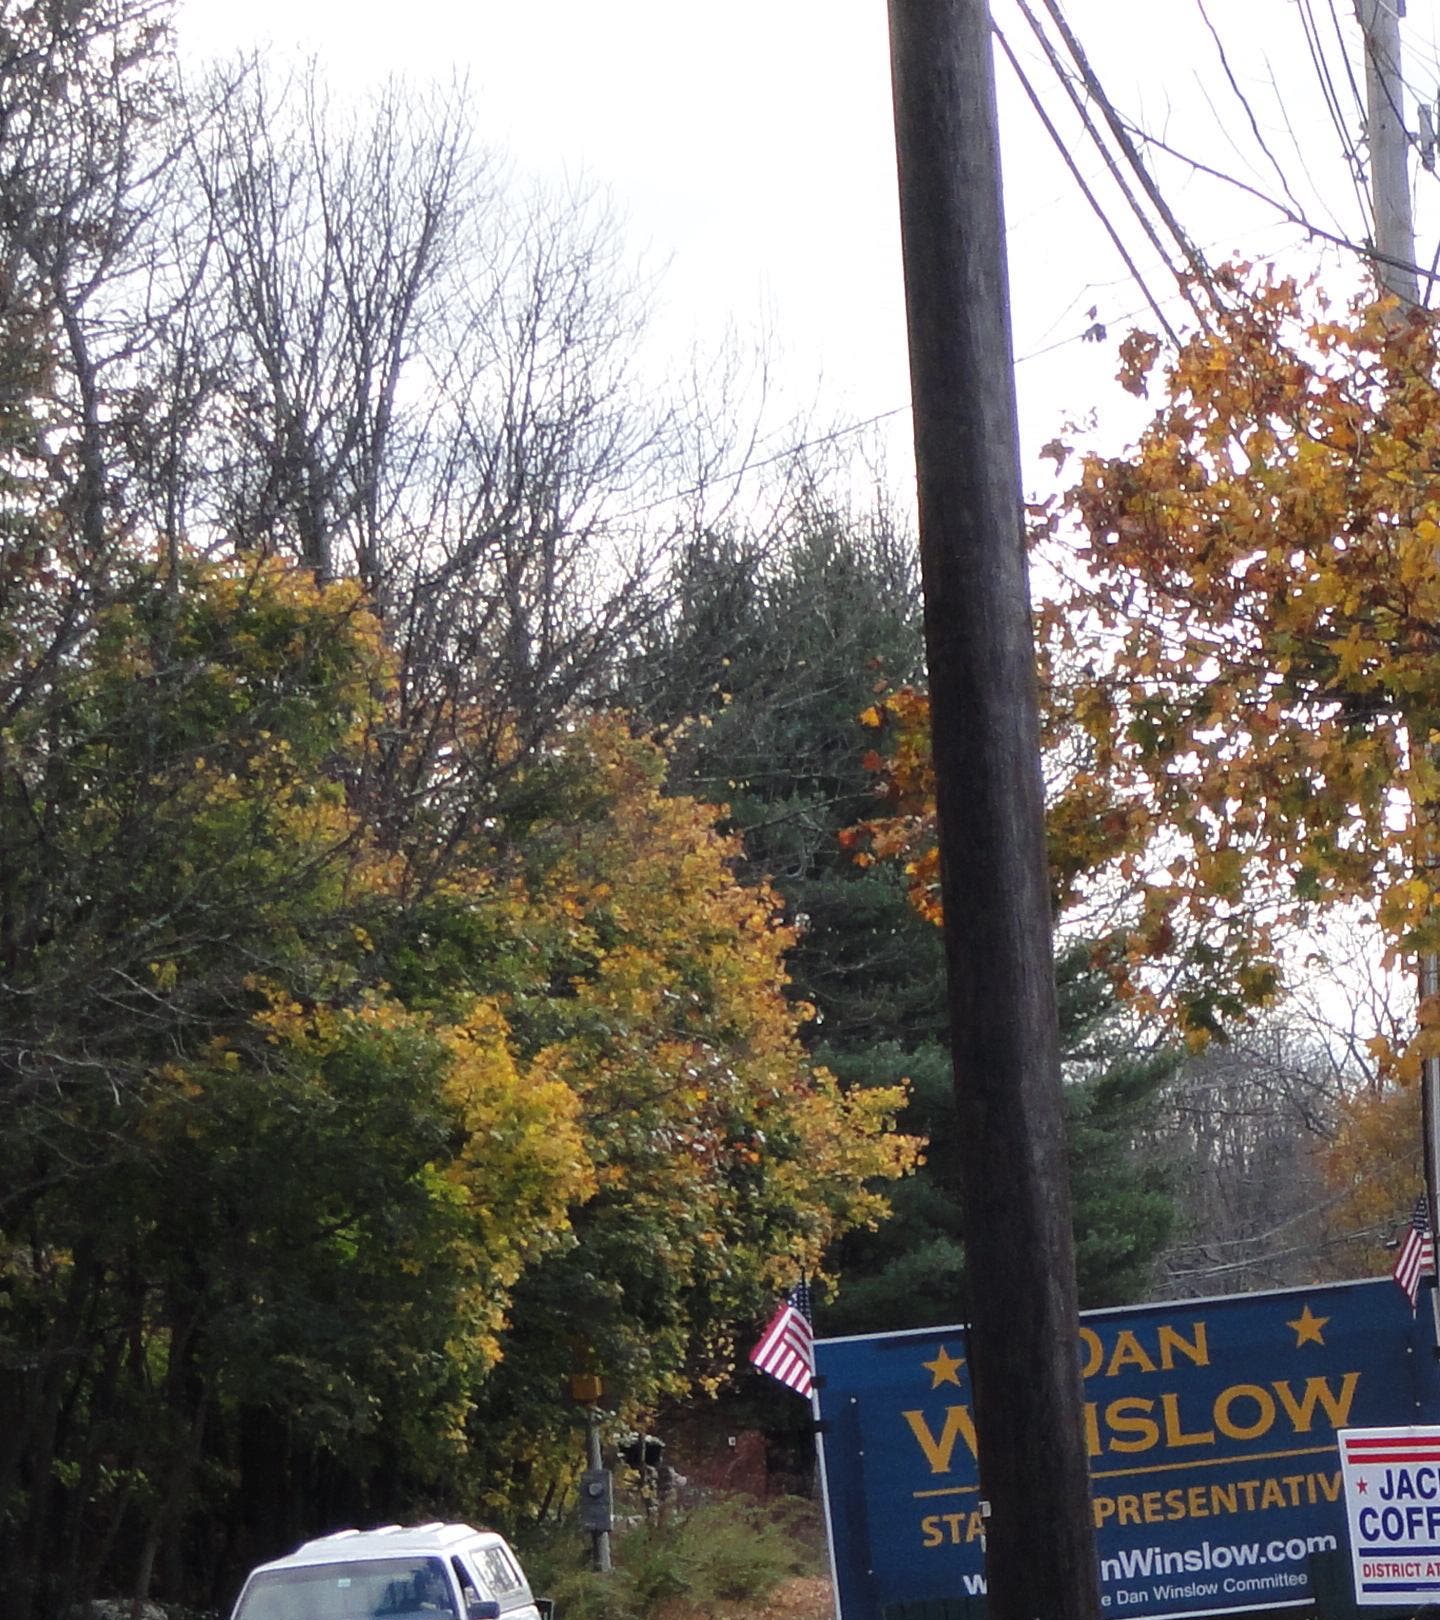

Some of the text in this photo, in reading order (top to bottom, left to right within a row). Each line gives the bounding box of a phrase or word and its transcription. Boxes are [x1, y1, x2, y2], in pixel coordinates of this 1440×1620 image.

[901, 1372, 1361, 1473] WSLOW
[921, 1471, 1342, 1547] STA PRESENTATIV
[1117, 1589, 1148, 1605] Dan
[1153, 1582, 1218, 1600] Winslow
[1223, 1572, 1308, 1592] Committee
[1363, 1563, 1421, 1578] DISTRICT
